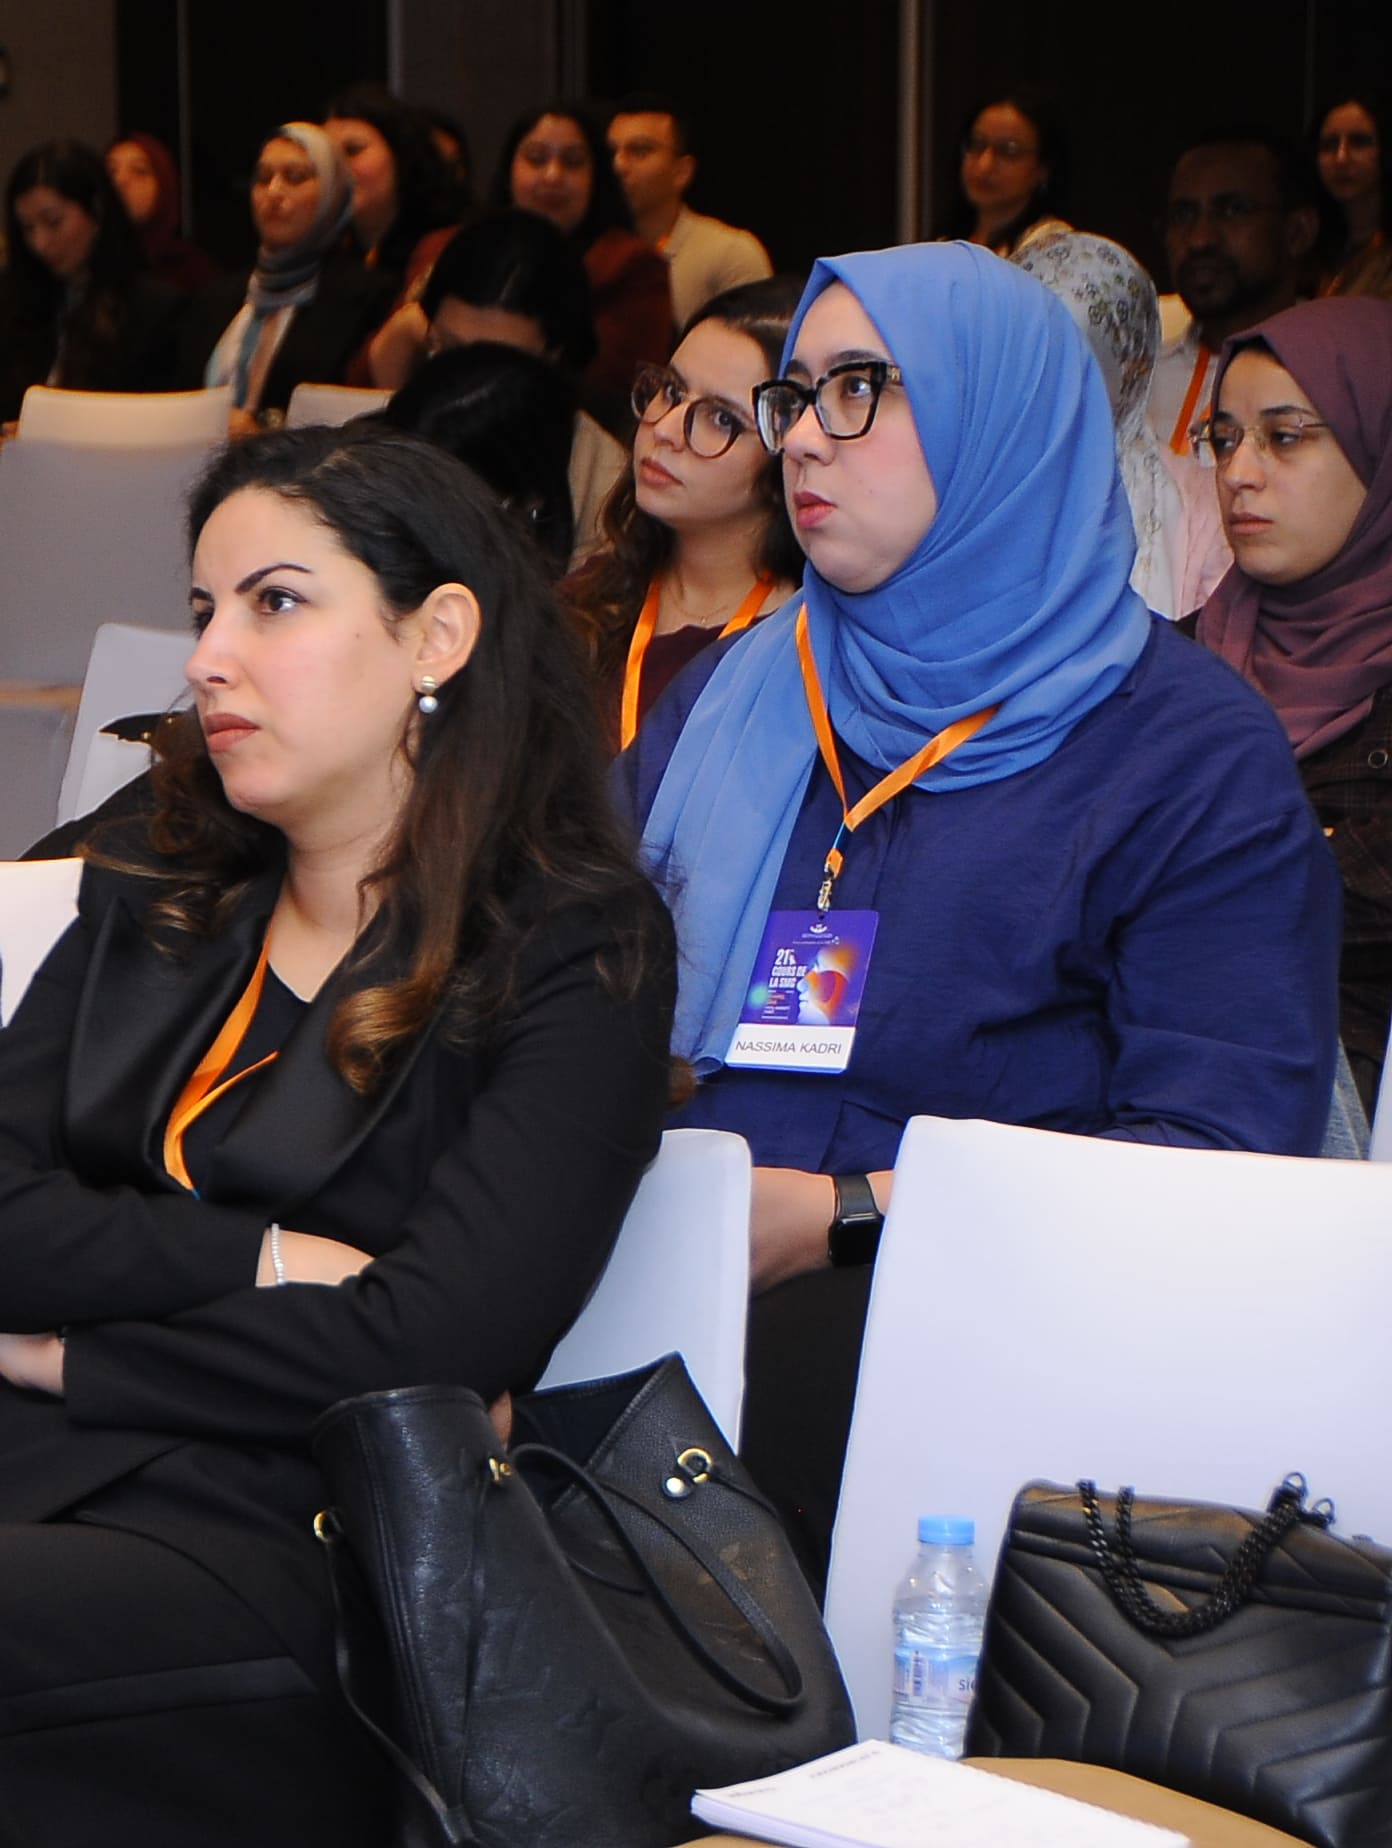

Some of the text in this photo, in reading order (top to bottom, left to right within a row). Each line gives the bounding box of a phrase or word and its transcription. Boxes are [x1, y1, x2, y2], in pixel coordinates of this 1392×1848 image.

[769, 977, 779, 988] LA
[735, 1040, 842, 1055] NASSIMA KADRI
